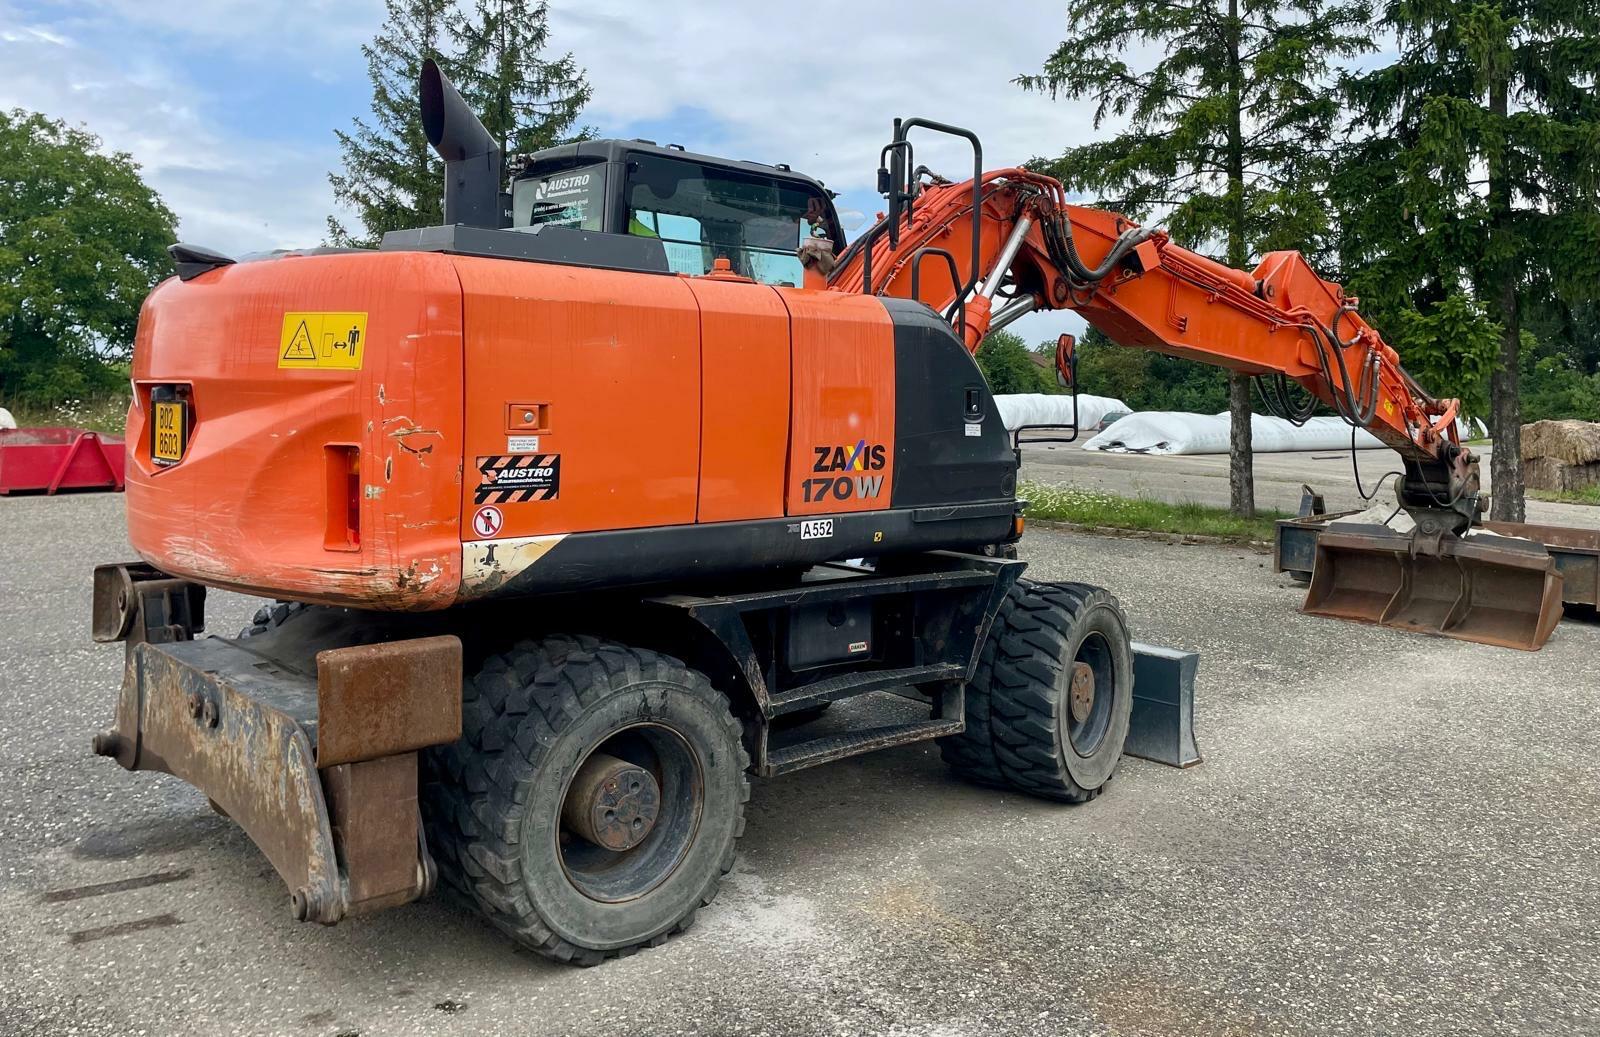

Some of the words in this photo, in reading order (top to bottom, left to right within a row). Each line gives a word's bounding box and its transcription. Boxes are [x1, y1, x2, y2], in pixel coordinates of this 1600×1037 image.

[547, 175, 590, 191] AUSTRO
[160, 433, 177, 455] 8603
[813, 440, 886, 473] ZAXIS
[498, 467, 553, 479] AUSTRO
[802, 475, 884, 502] 170W
[803, 521, 832, 537] A552
